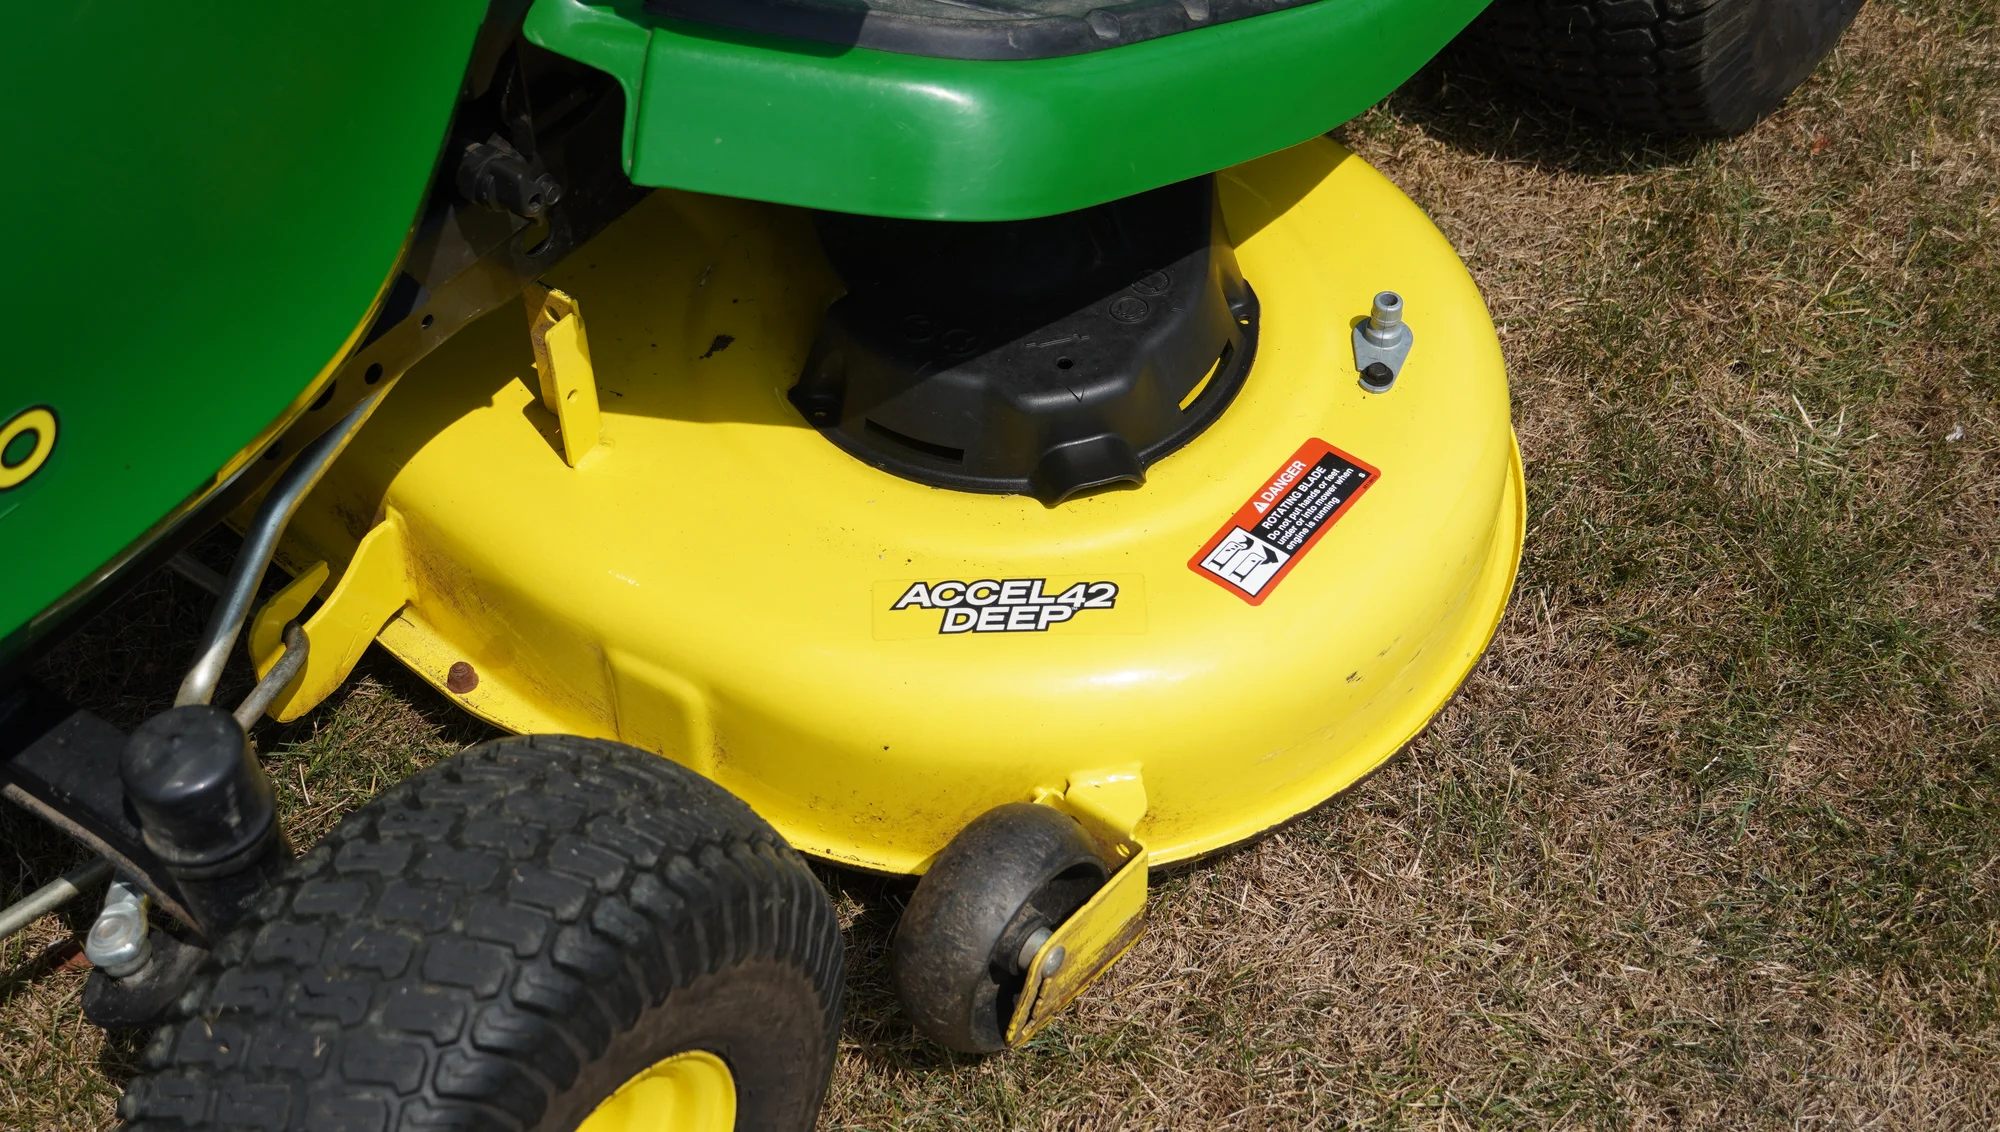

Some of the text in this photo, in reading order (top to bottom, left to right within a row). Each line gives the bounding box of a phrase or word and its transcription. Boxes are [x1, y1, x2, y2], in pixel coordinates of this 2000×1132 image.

[1260, 460, 1307, 502] DANGER
[1261, 466, 1327, 530] ROTATING BLADE
[1267, 468, 1341, 541] Do not put hands or feet
[1277, 468, 1355, 545] under or into mower when
[1286, 496, 1341, 550] engine is running
